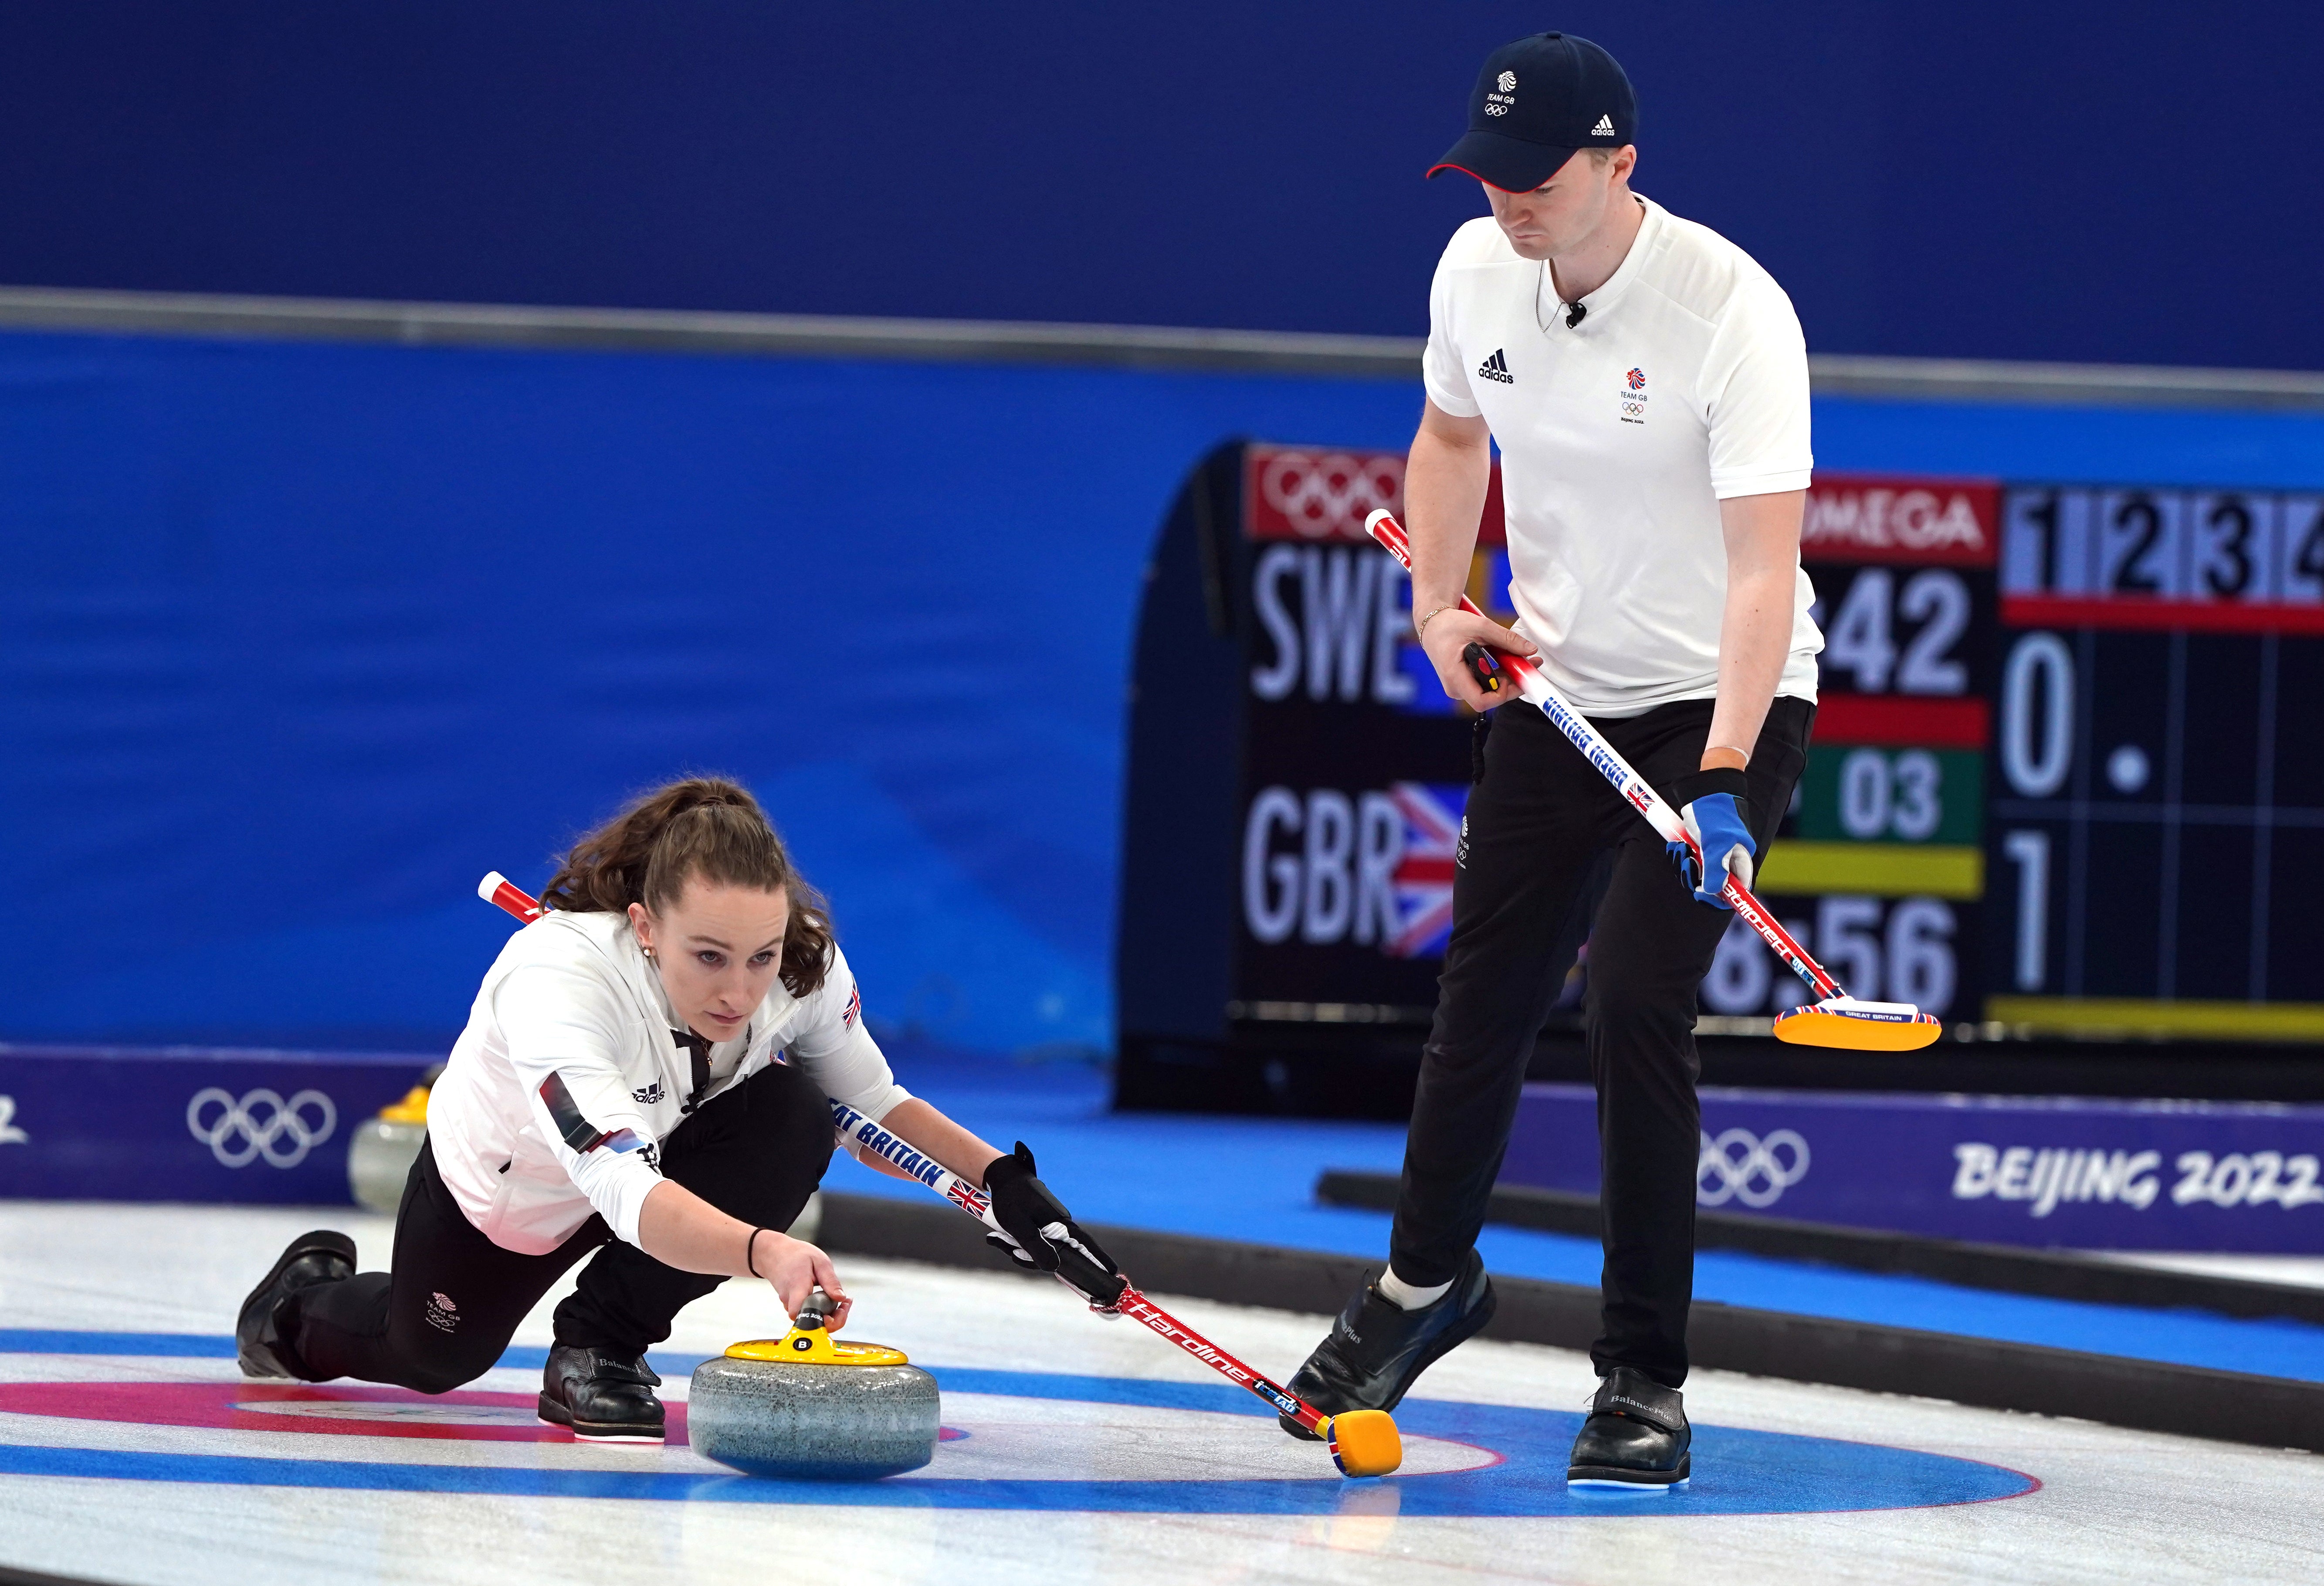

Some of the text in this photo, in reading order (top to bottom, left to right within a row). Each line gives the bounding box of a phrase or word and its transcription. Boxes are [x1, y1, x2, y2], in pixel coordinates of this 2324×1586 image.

[1487, 93, 1515, 105] TEAM GB
[1591, 128, 1615, 136] adidas
[1478, 367, 1514, 384] adidas
[1621, 391, 1637, 400] TEAM
[2024, 489, 2059, 590] 1
[2111, 497, 2162, 592] 2
[2202, 500, 2253, 597] 3
[1252, 546, 1415, 700] SWE
[1810, 570, 1970, 694] 42
[1543, 697, 1628, 792] GREAT BRITAIN
[2005, 634, 2073, 796] 0
[1841, 748, 1942, 840] 03
[1244, 787, 1406, 945] GBR
[2005, 830, 2050, 990] 1
[856, 1122, 946, 1188] BRITAIN
[1952, 1142, 2324, 1217] BEIJING 2022
[427, 1300, 446, 1316] TEAM
[1128, 1303, 1250, 1382] Hardline
